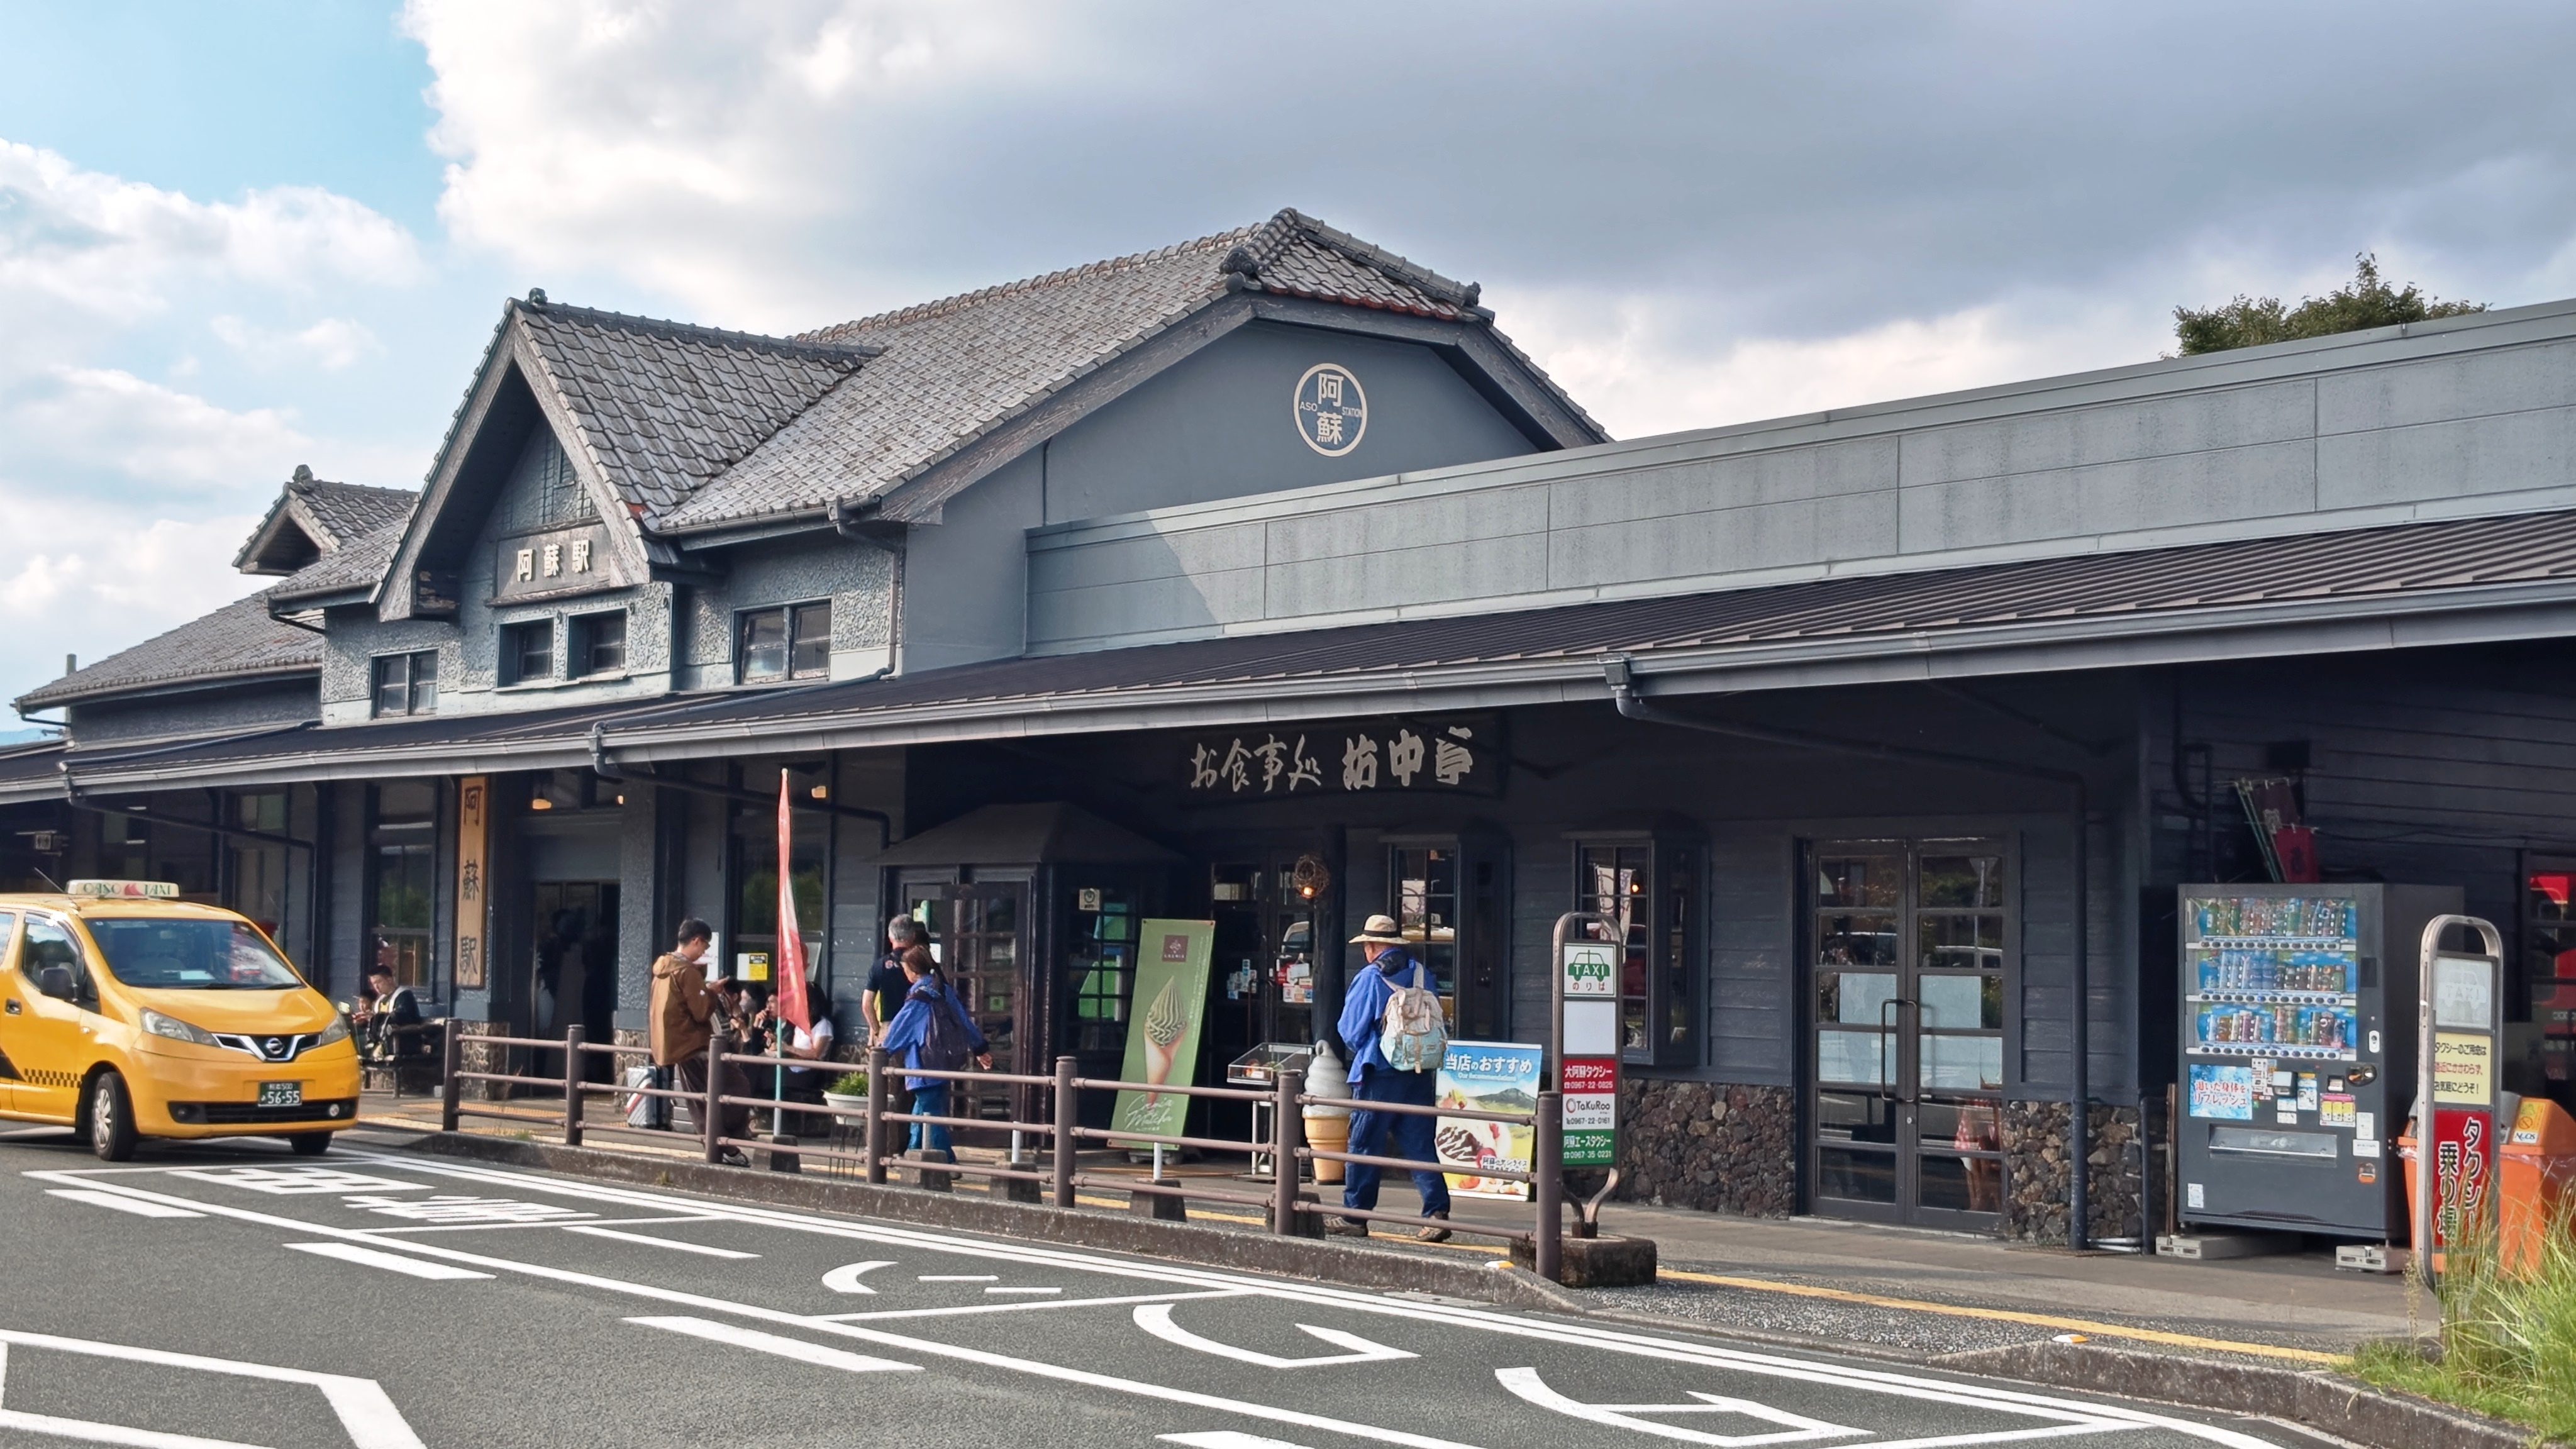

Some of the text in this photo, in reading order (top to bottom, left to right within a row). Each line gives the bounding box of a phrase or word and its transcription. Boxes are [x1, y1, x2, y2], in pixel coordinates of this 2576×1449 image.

[1299, 401, 1363, 418] ASO STATION
[1318, 373, 1344, 445] 阿蘇
[517, 539, 589, 582] 阿蘇駅
[1190, 733, 1321, 793] お食事処
[459, 785, 484, 975] 阿蘇駅
[144, 884, 172, 896] TAXI
[1574, 964, 1604, 975] TAXI
[1572, 982, 1605, 991] のりば
[2446, 985, 2480, 1001] TAXI
[1445, 1053, 1533, 1074] 当店のおすすめ
[267, 1091, 300, 1104] 56-55
[2195, 1092, 2247, 1105] リフレッシュ
[1576, 1101, 1611, 1111] TaKuRoo
[2463, 1116, 2482, 1241] タクシー
